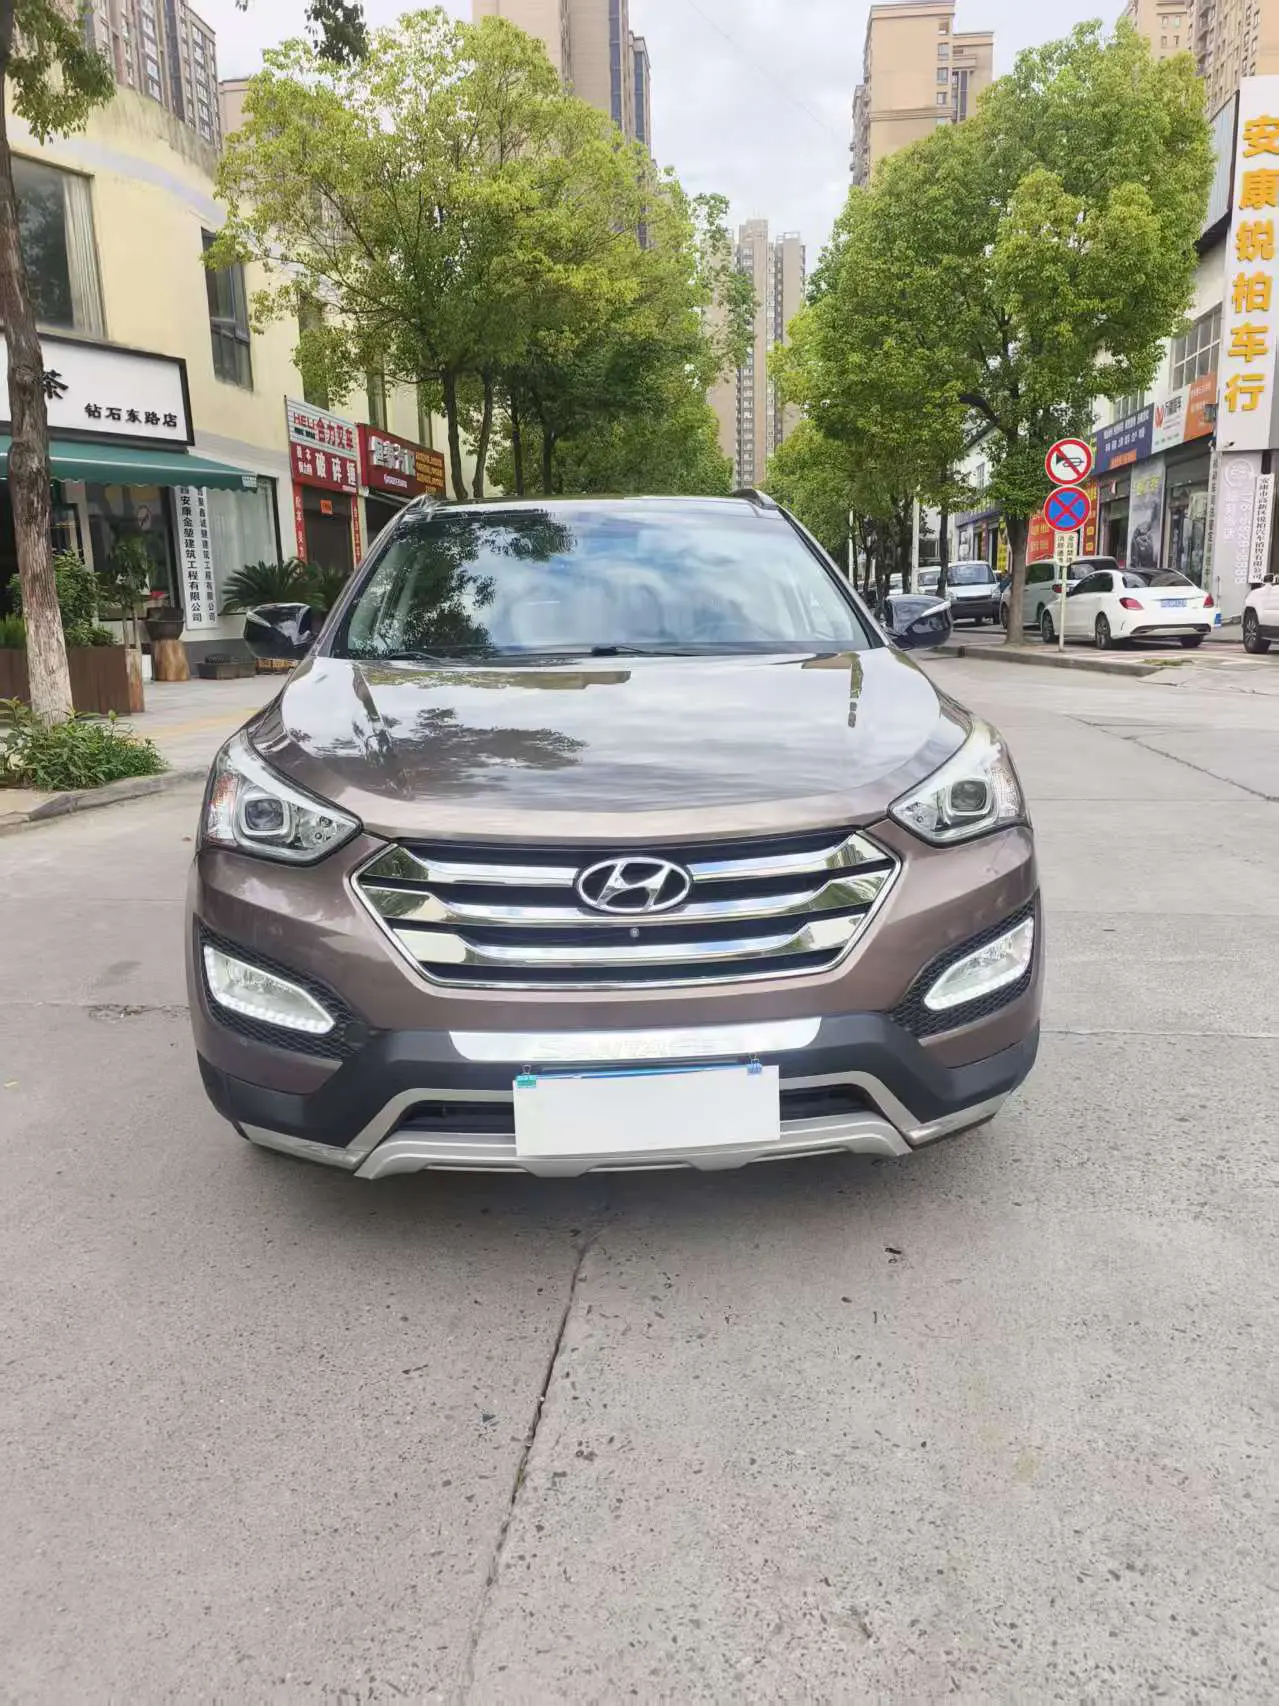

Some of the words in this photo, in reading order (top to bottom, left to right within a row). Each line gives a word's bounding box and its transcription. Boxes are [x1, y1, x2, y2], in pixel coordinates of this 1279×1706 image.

[1224, 114, 1279, 413] 安康锐柏车行
[84, 402, 178, 428] 钻石东路店
